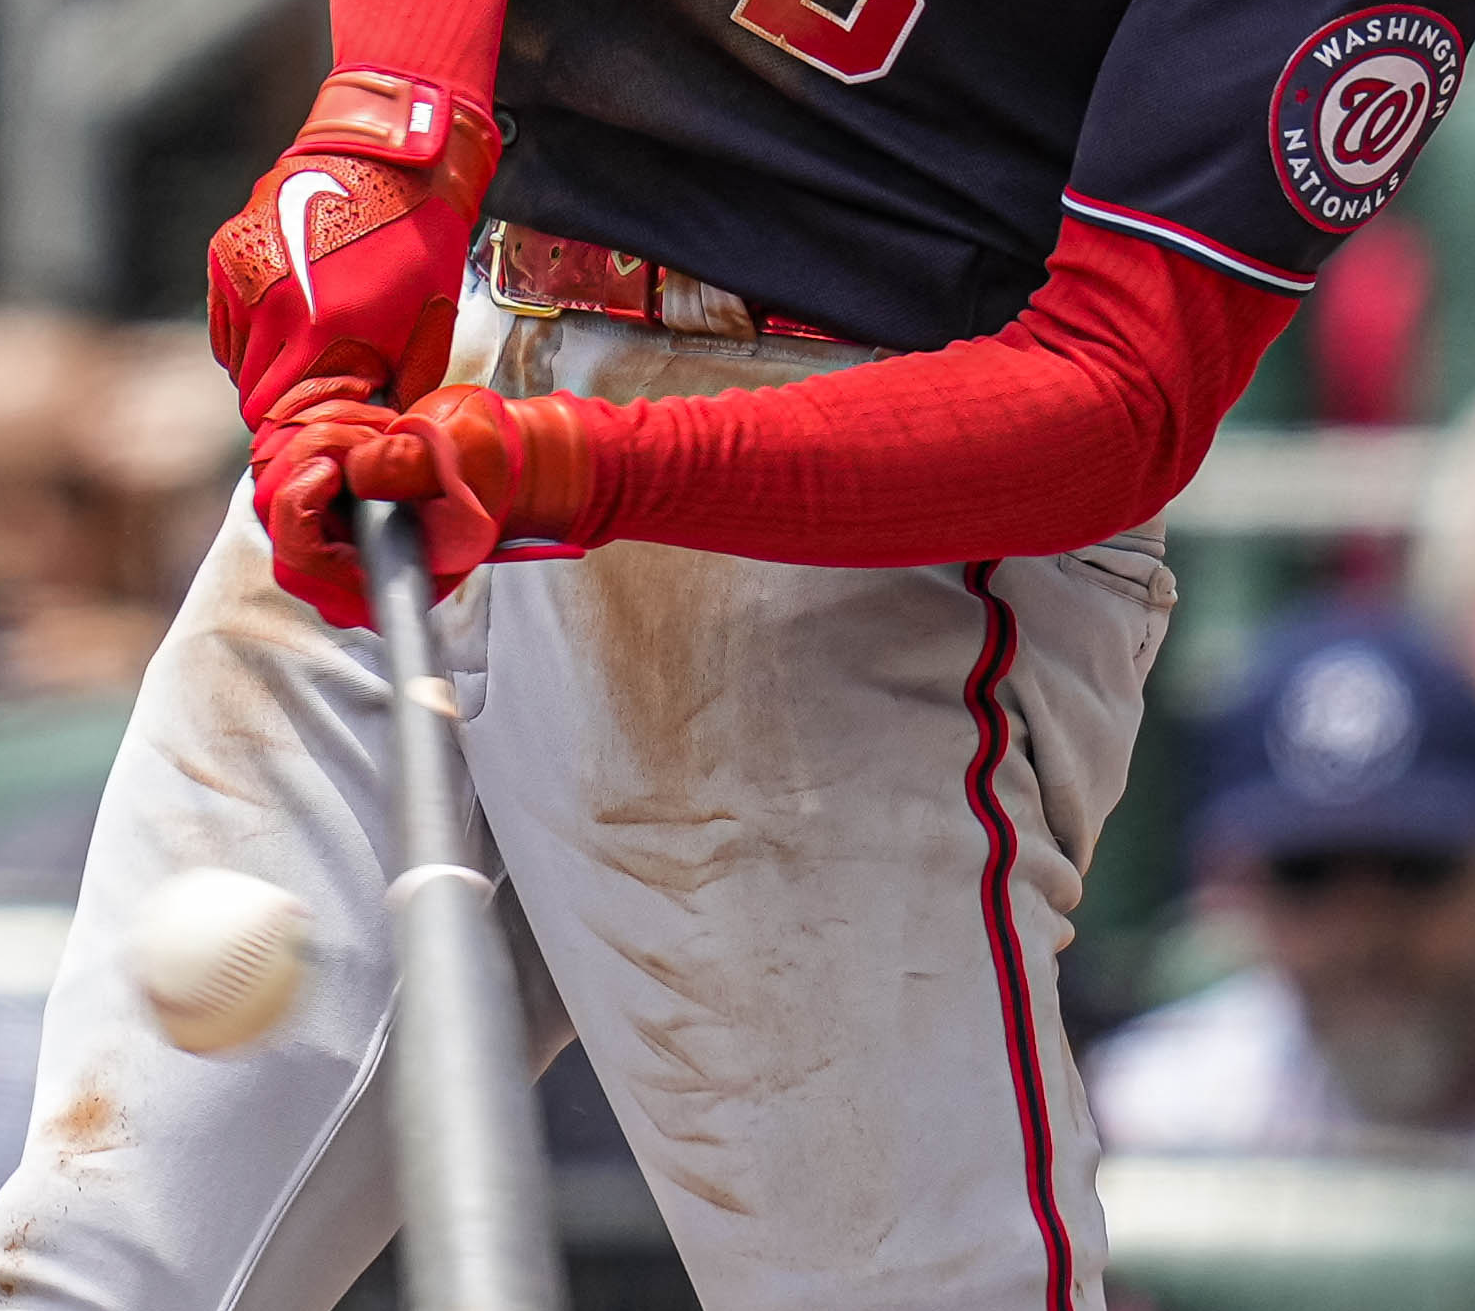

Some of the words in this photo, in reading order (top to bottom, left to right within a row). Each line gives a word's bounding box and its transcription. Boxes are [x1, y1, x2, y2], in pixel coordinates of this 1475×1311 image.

[1313, 17, 1456, 119] WASHINGTON
[1333, 78, 1427, 164] W
[1284, 128, 1399, 221] NATIONALS
